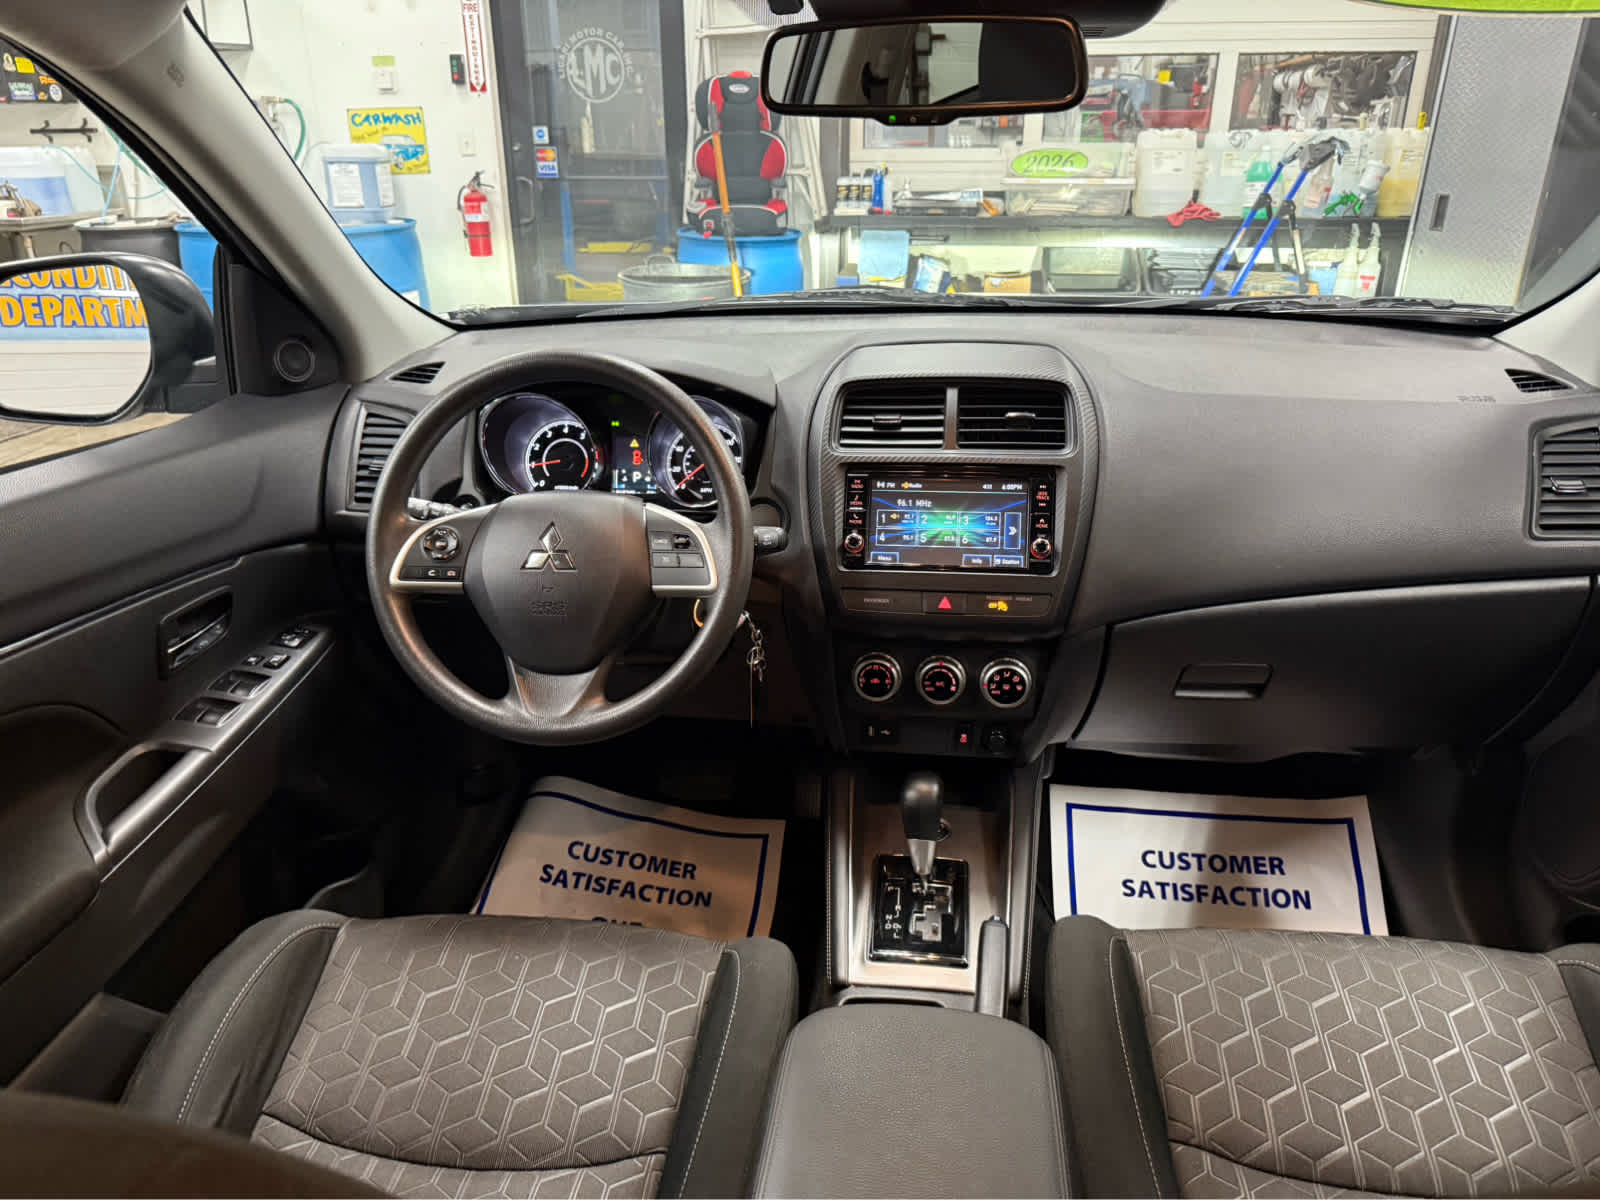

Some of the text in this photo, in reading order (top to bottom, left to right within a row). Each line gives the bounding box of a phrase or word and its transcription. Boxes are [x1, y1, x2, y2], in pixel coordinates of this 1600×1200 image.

[463, 3, 479, 12] FIRE
[1024, 152, 1076, 173] 2026
[632, 471, 643, 483] P
[915, 499, 932, 507] MHz
[567, 840, 697, 880] CUSTOMER
[1141, 849, 1287, 876] CUSTOMER
[539, 863, 713, 908] SATISFACTION
[1121, 878, 1312, 911] SATISFACTION
